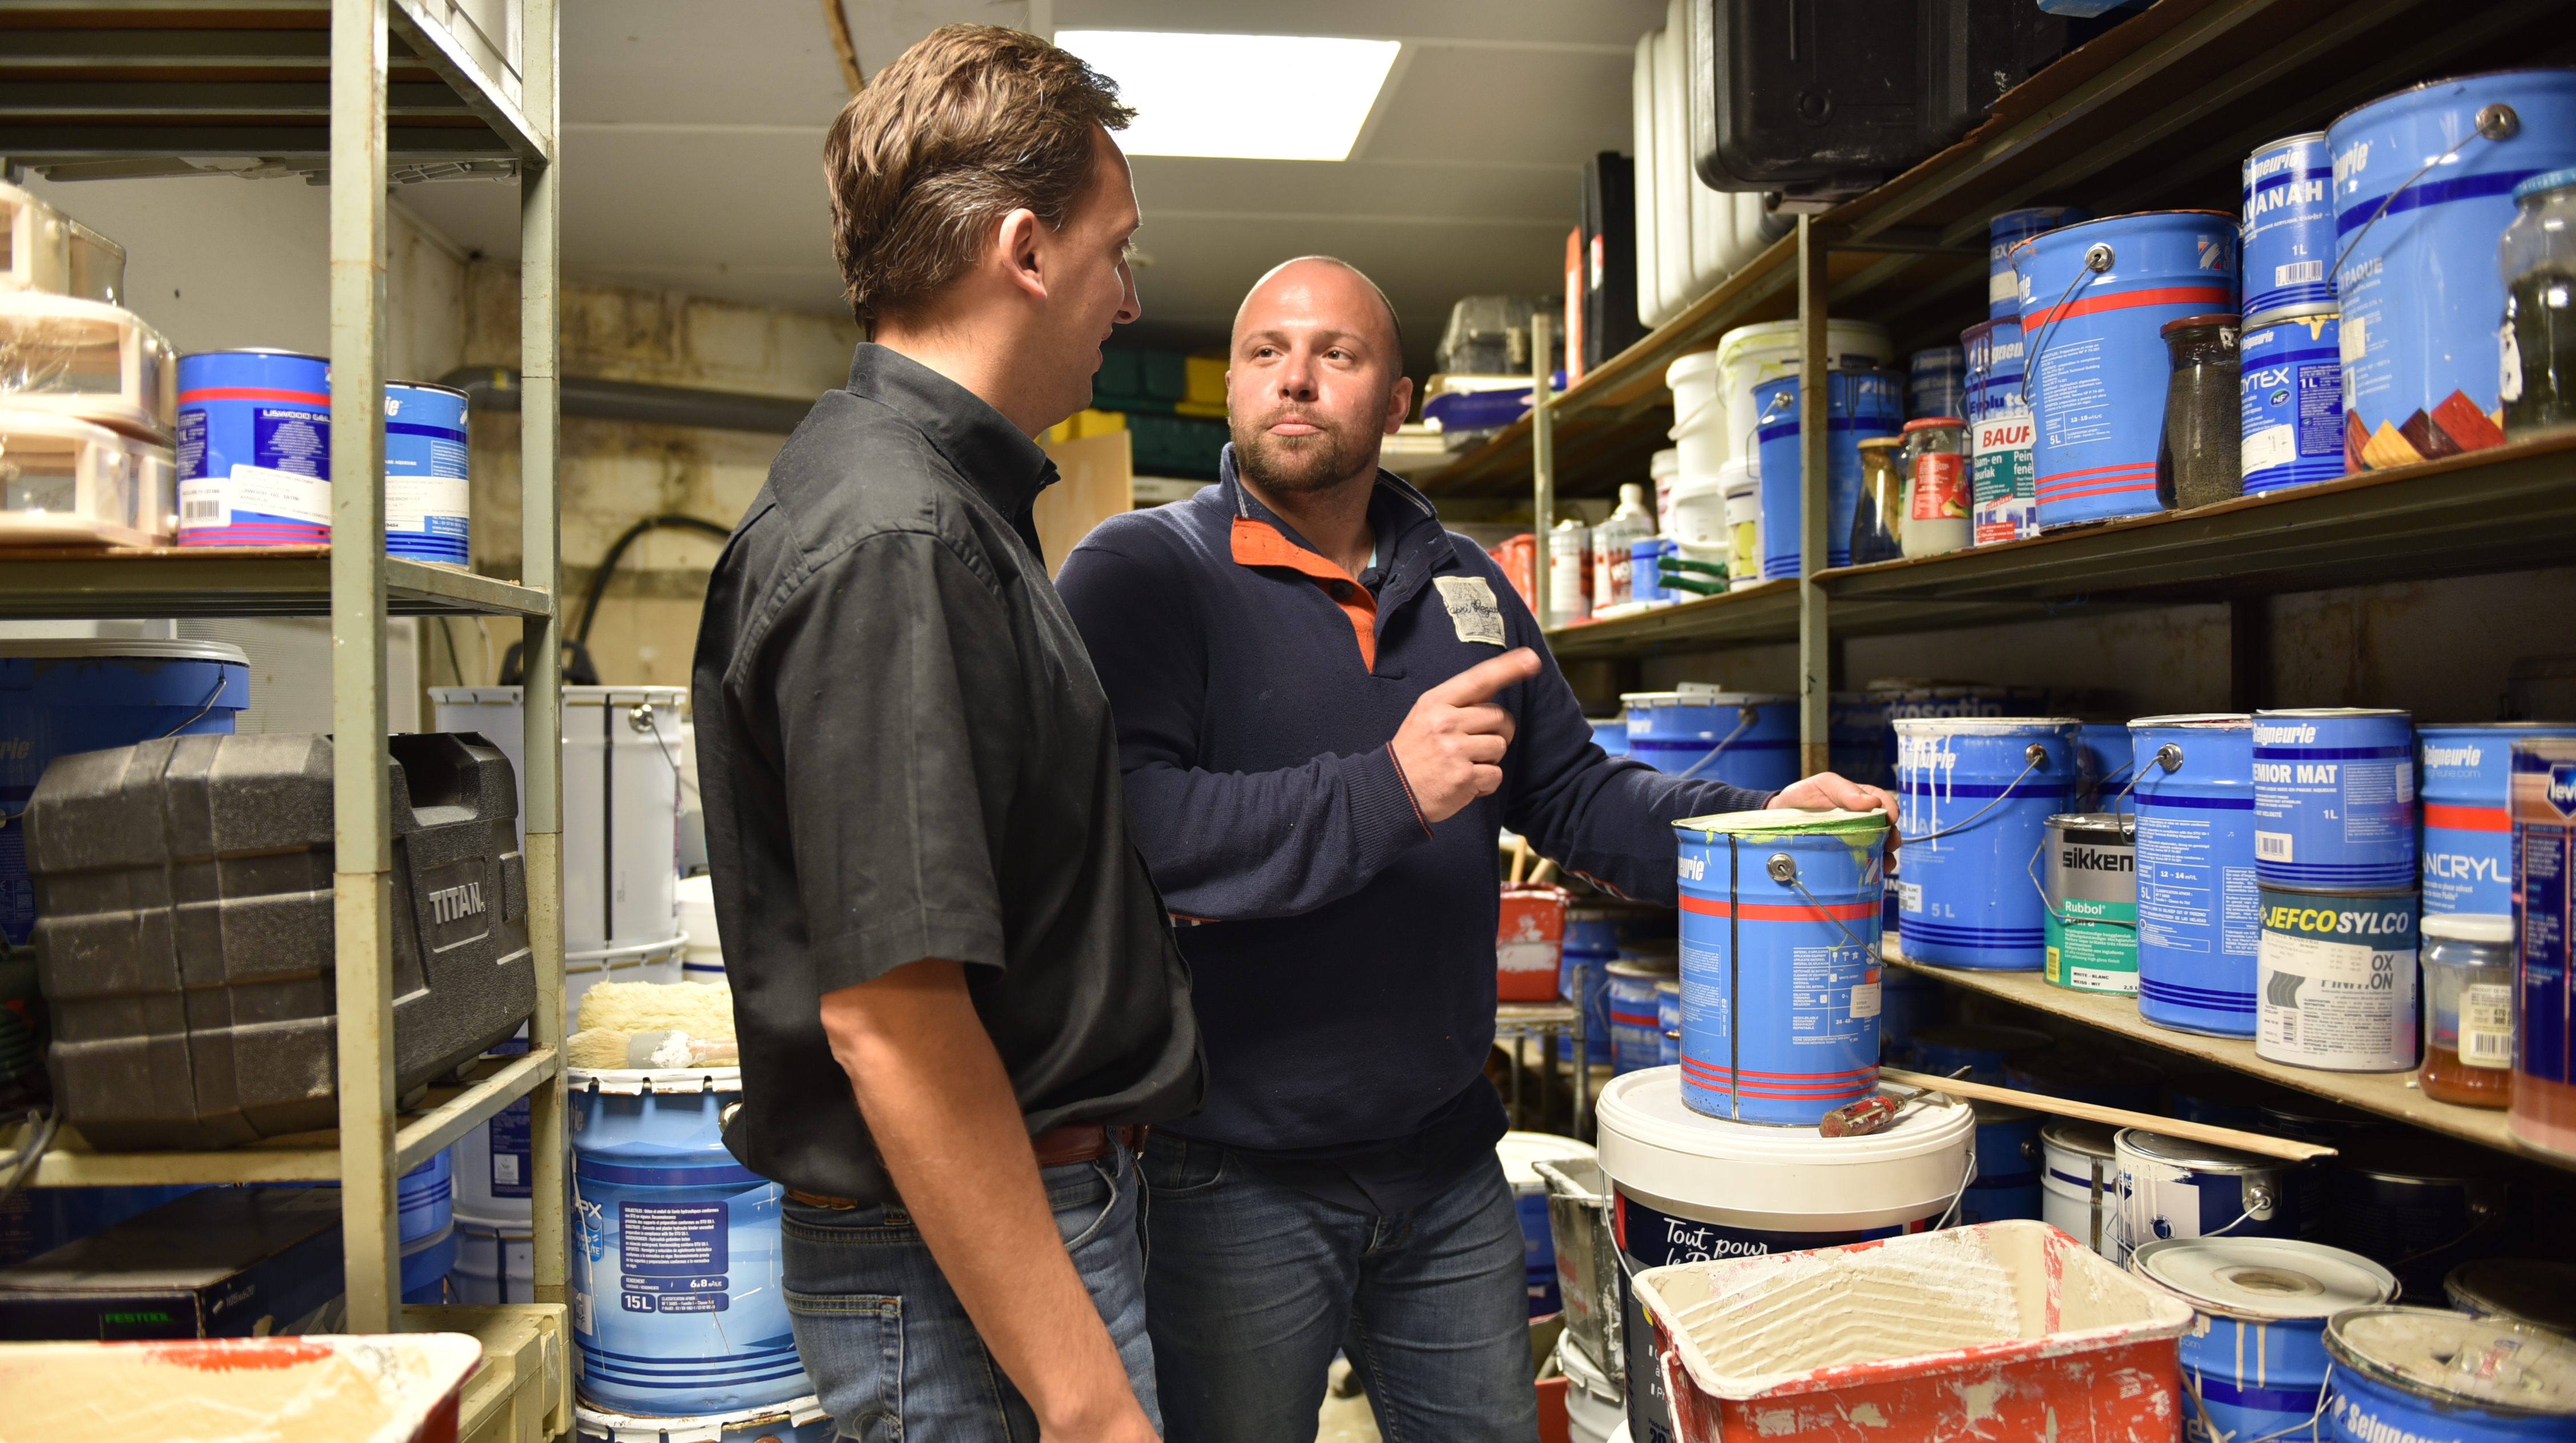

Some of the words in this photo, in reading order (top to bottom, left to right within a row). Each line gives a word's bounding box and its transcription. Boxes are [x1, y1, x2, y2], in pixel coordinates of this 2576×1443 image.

[263, 409, 311, 420] LISWOOD
[2050, 434, 2061, 445] 5L
[1992, 455, 2002, 463] en
[2253, 723, 2316, 746] Seigneurie
[2297, 765, 2337, 784] MAT
[2323, 809, 2338, 819] 1L
[2141, 886, 2151, 899] 5L
[429, 882, 484, 925] TITAN
[2065, 901, 2103, 915] Rubbol
[2372, 954, 2394, 972] OX
[1664, 1218, 1714, 1250] Tout
[1713, 1239, 1768, 1259] pour
